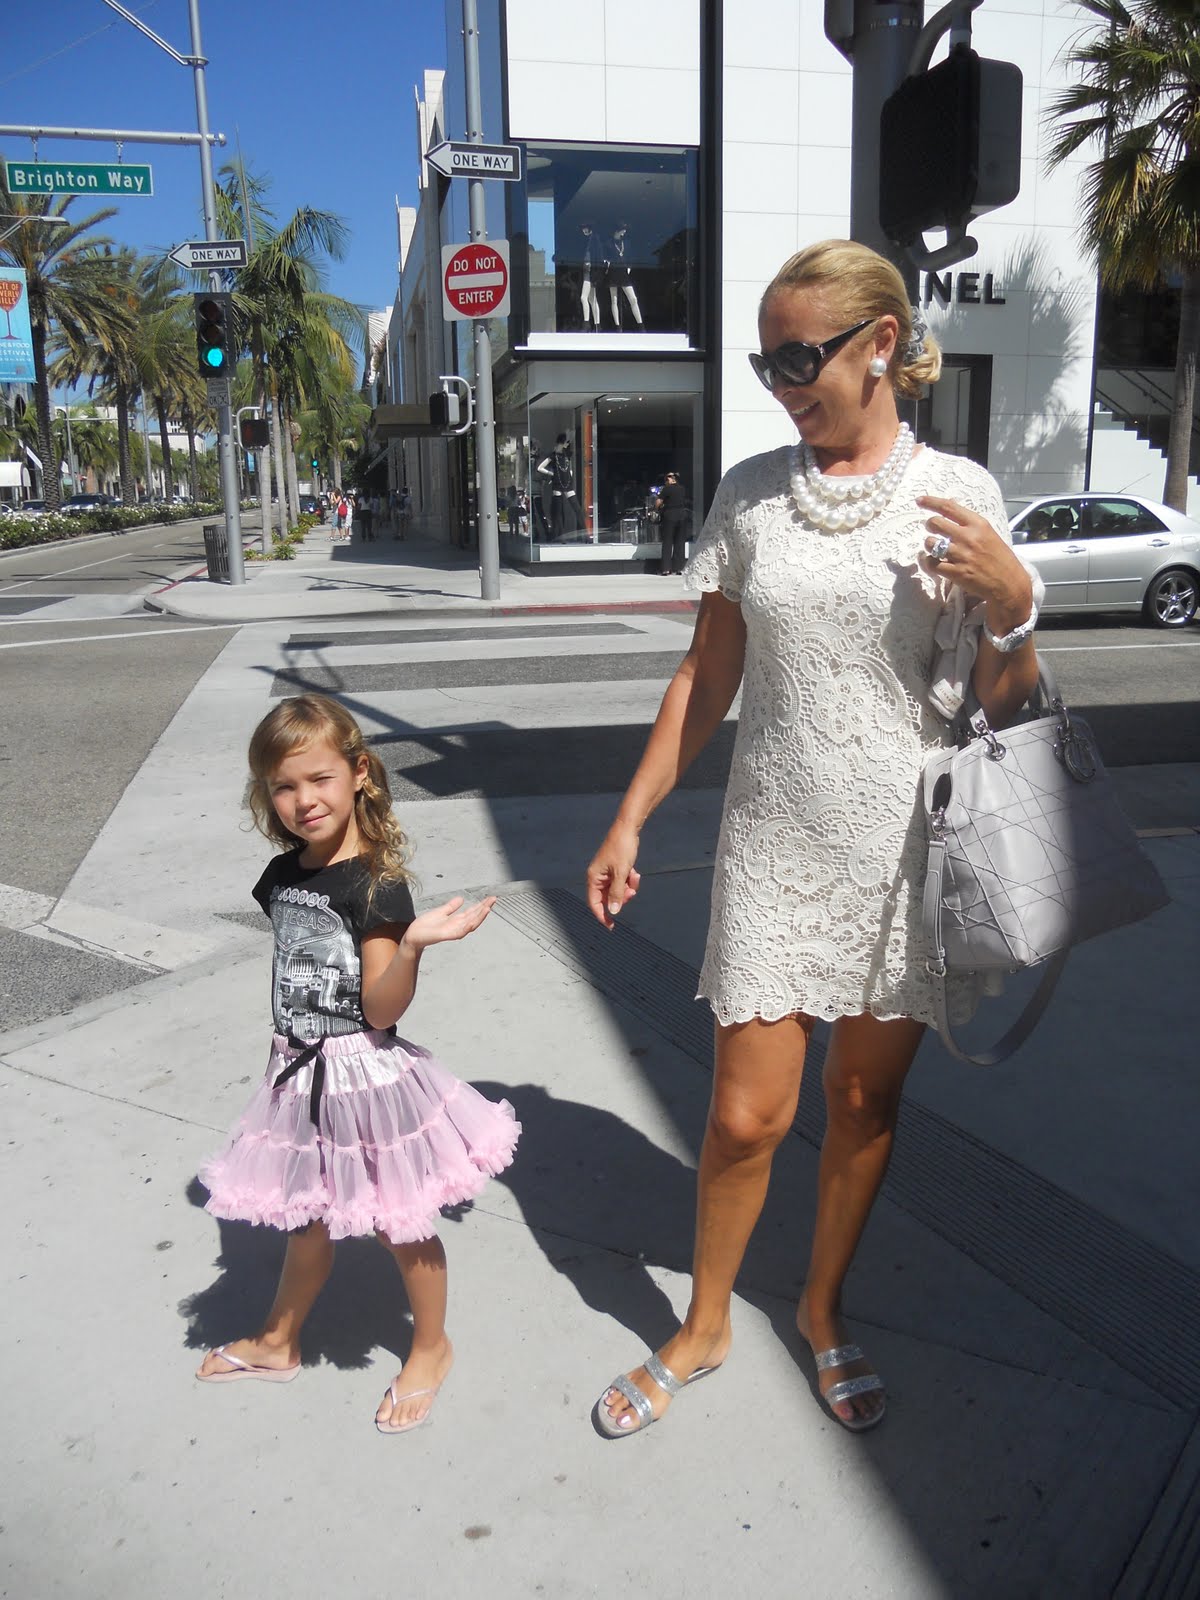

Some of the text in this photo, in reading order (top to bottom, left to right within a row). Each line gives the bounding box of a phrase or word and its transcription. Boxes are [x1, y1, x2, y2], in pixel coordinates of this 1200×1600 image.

[453, 153, 509, 168] ONE WAY
[14, 169, 144, 192] Brighton Way
[192, 249, 237, 260] ONE WAY
[453, 256, 497, 272] DO NOT
[11, 283, 19, 291] OF
[919, 272, 1006, 304] NEL
[458, 290, 494, 305] ENTER
[283, 906, 331, 934] VEGAS
